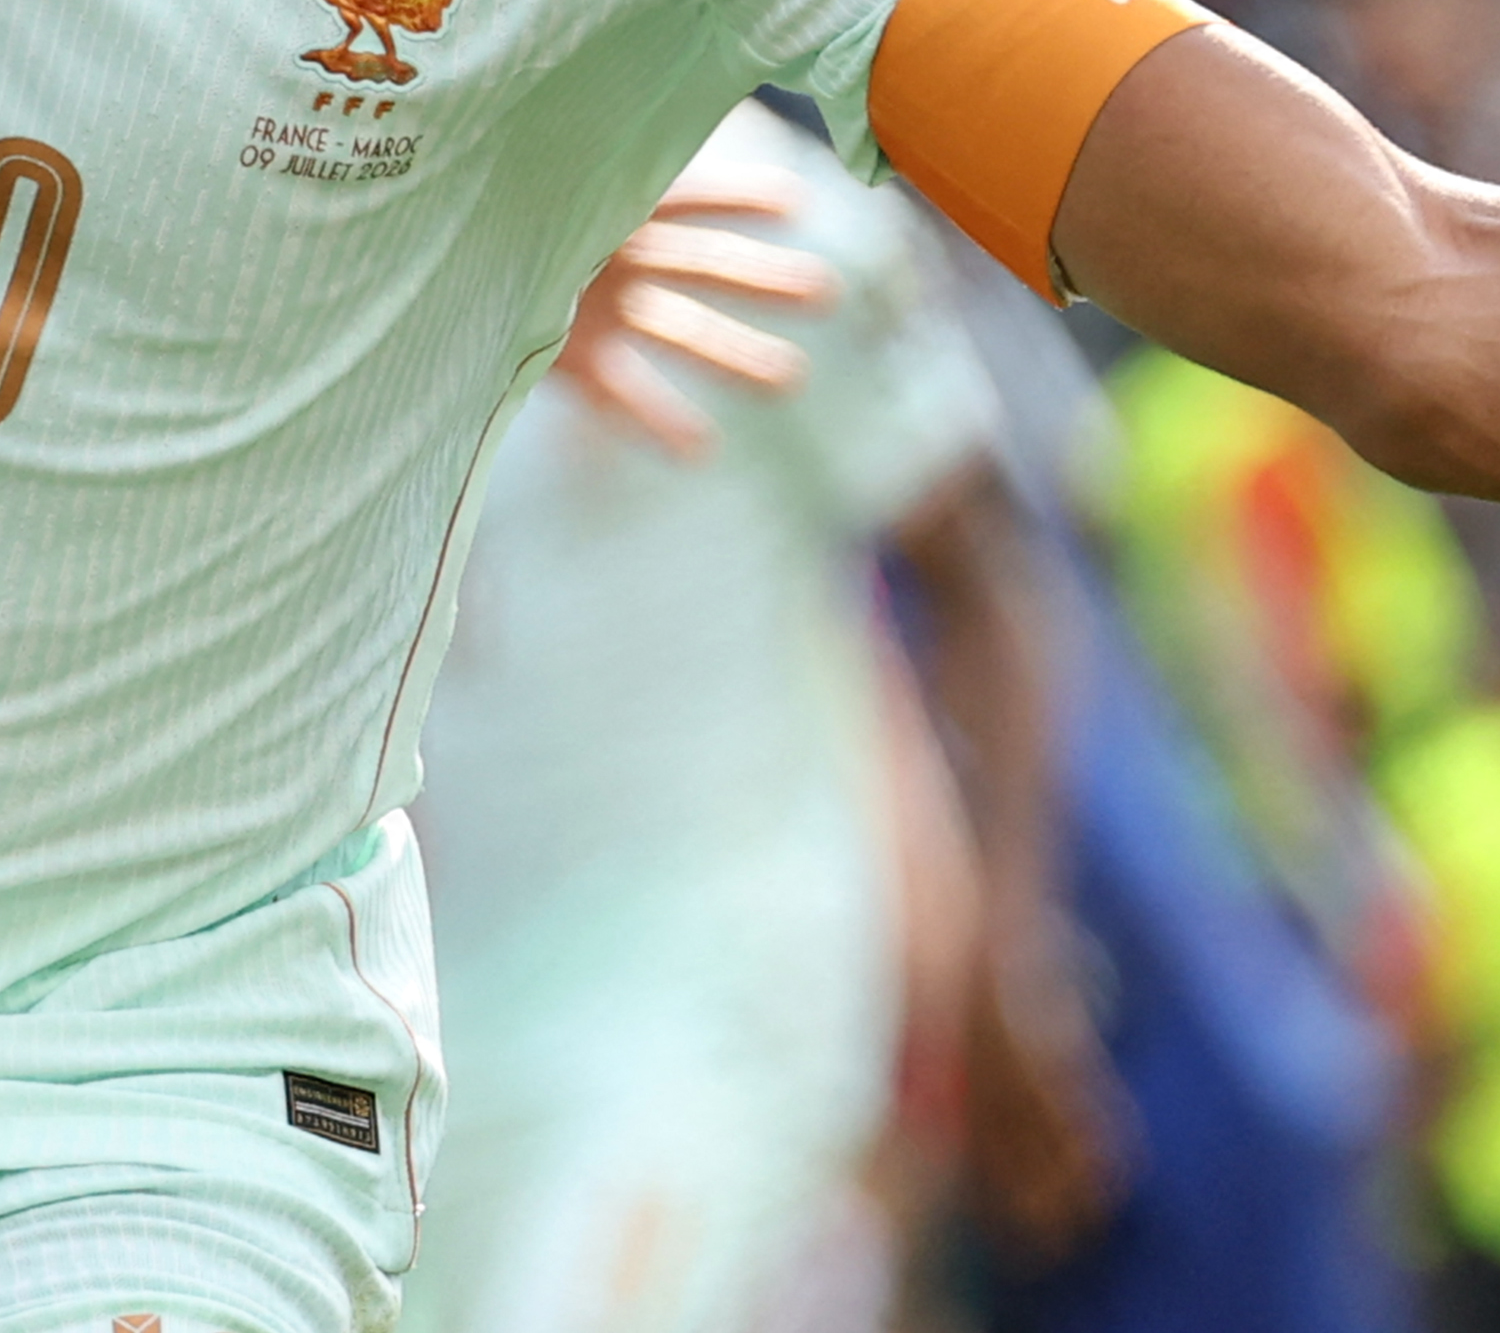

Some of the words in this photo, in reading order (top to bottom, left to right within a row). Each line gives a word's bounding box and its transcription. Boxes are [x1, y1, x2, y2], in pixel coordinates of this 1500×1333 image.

[252, 116, 330, 153] FRANCE
[351, 135, 424, 159] MAROC
[240, 145, 276, 171] 09
[280, 154, 354, 182] JUILLET
